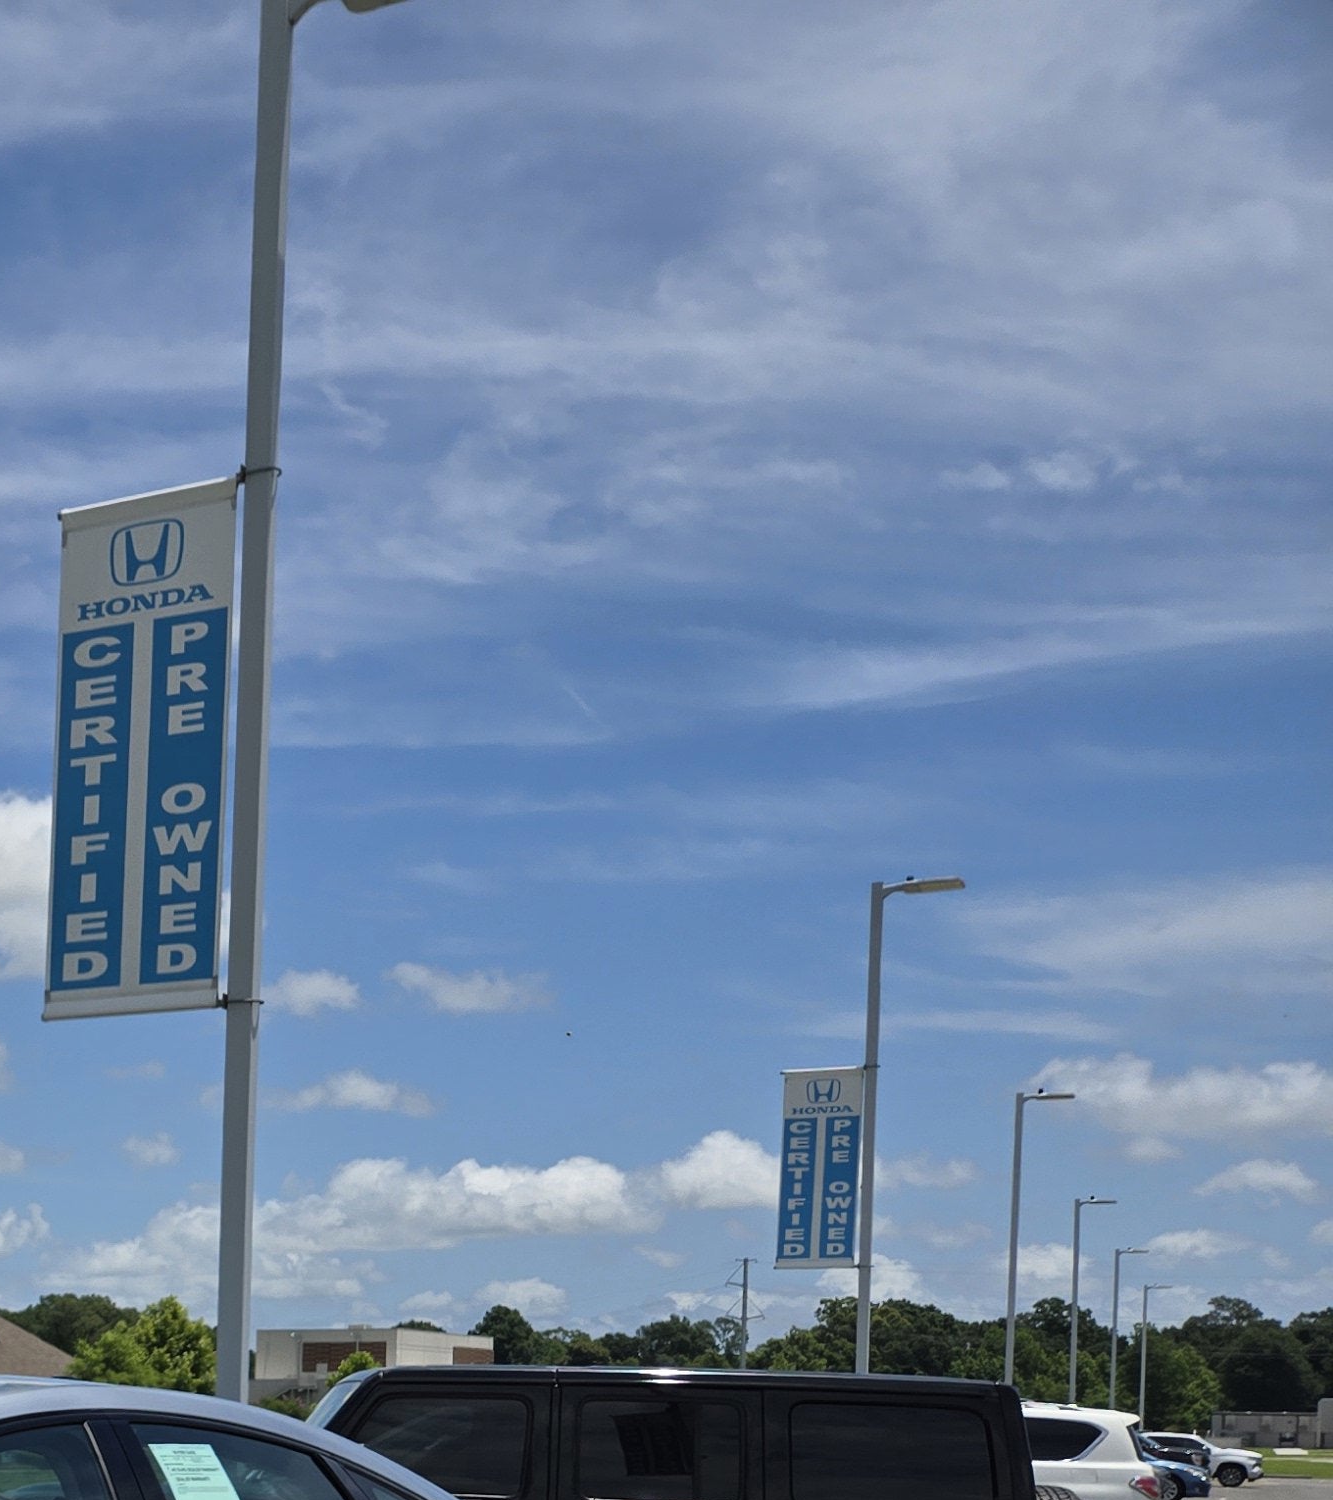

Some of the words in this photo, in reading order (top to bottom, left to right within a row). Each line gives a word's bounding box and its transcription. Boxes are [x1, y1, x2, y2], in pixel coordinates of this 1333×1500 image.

[77, 584, 214, 622] HONDA
[165, 620, 210, 736] PRE
[61, 635, 122, 983] CERTIFIED
[152, 781, 213, 975] OWNED
[791, 1105, 854, 1115] HONDA
[831, 1118, 853, 1164] PRE
[783, 1121, 812, 1256] CERTIFIED
[824, 1180, 853, 1256] OWNED
